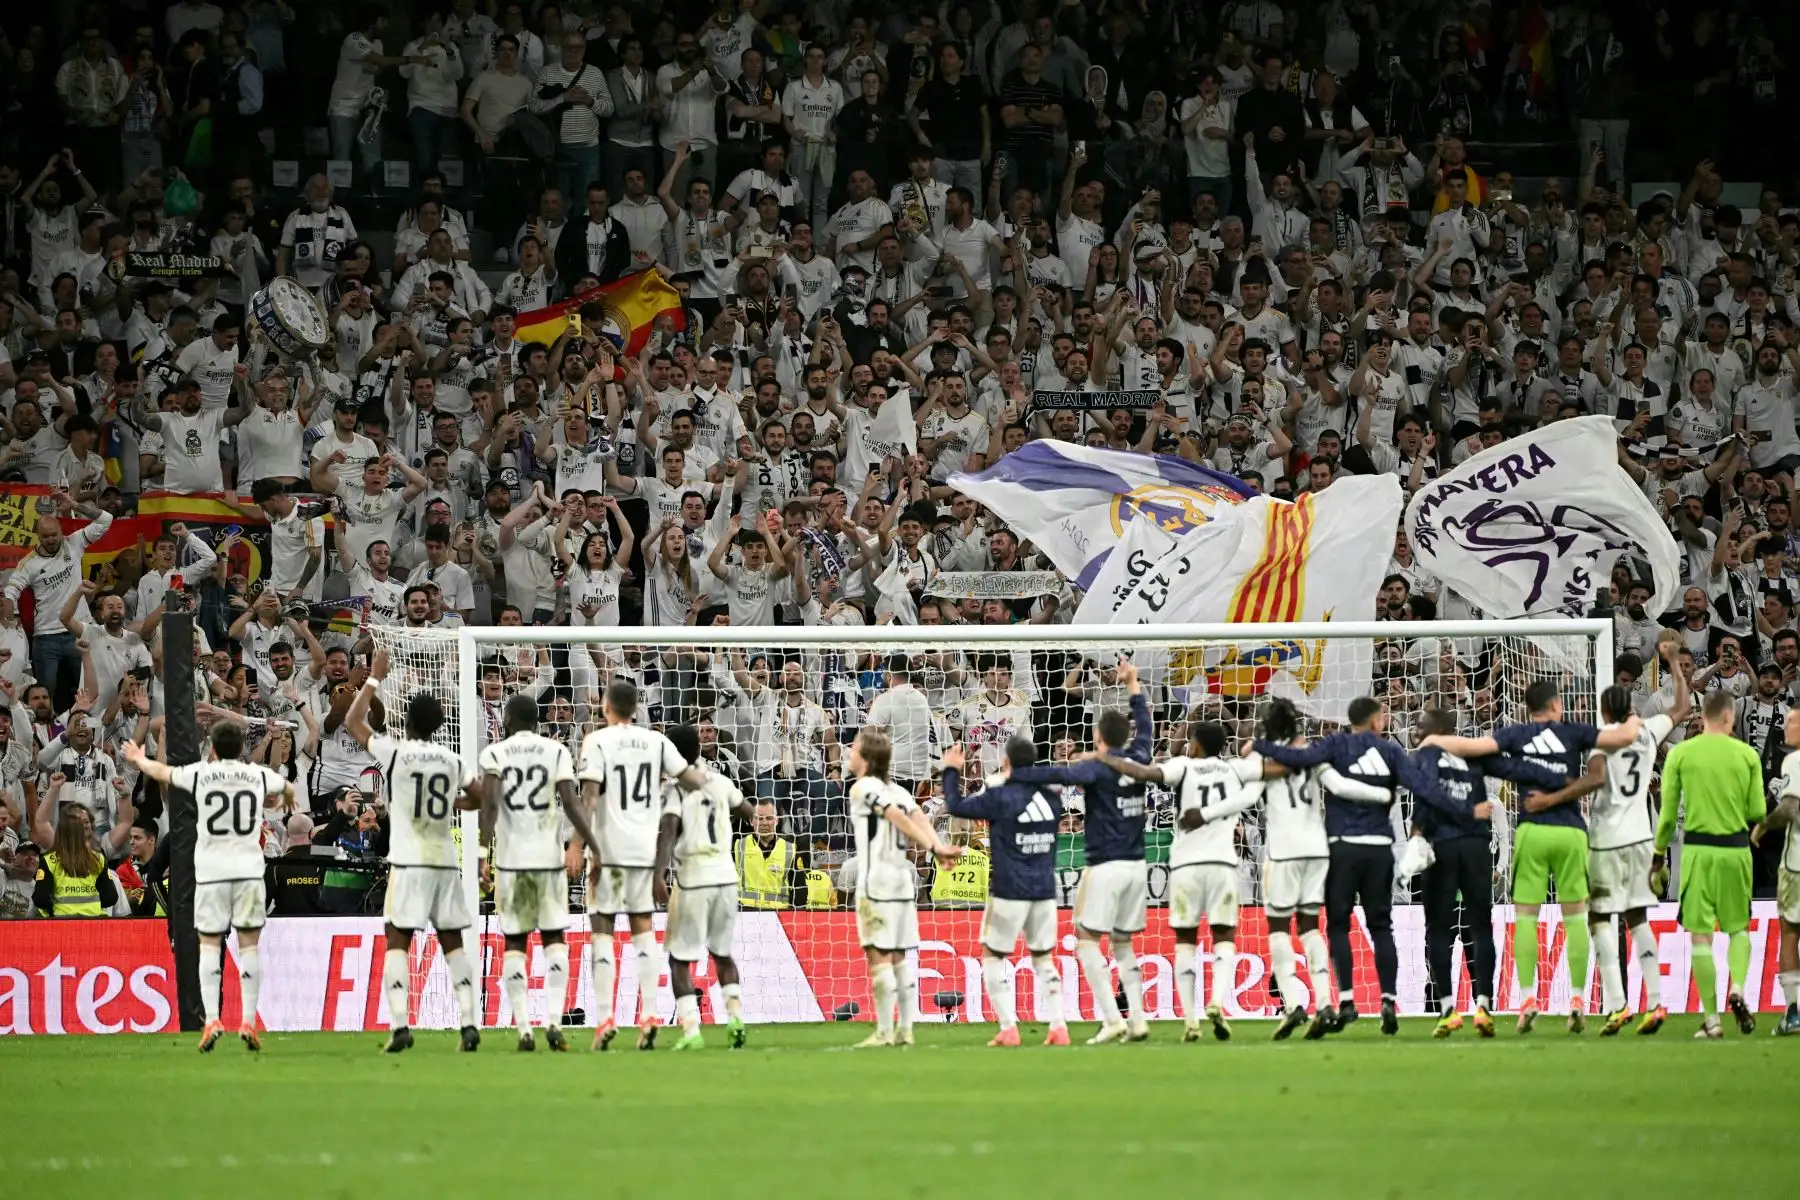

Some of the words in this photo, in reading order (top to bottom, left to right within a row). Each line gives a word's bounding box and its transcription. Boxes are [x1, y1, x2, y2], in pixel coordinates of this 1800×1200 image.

[802, 103, 833, 113] Emirates
[130, 252, 167, 268] Real
[168, 252, 221, 268] Madrid
[1035, 391, 1088, 407] REAL
[1091, 390, 1162, 407] MADRID
[951, 575, 992, 592] Real
[993, 575, 1047, 592] Madrid
[411, 771, 450, 820] 18
[501, 764, 550, 811] 22
[613, 762, 651, 811] 14
[1620, 751, 1641, 797] 3
[205, 790, 257, 836] 20
[701, 799, 717, 844] 7
